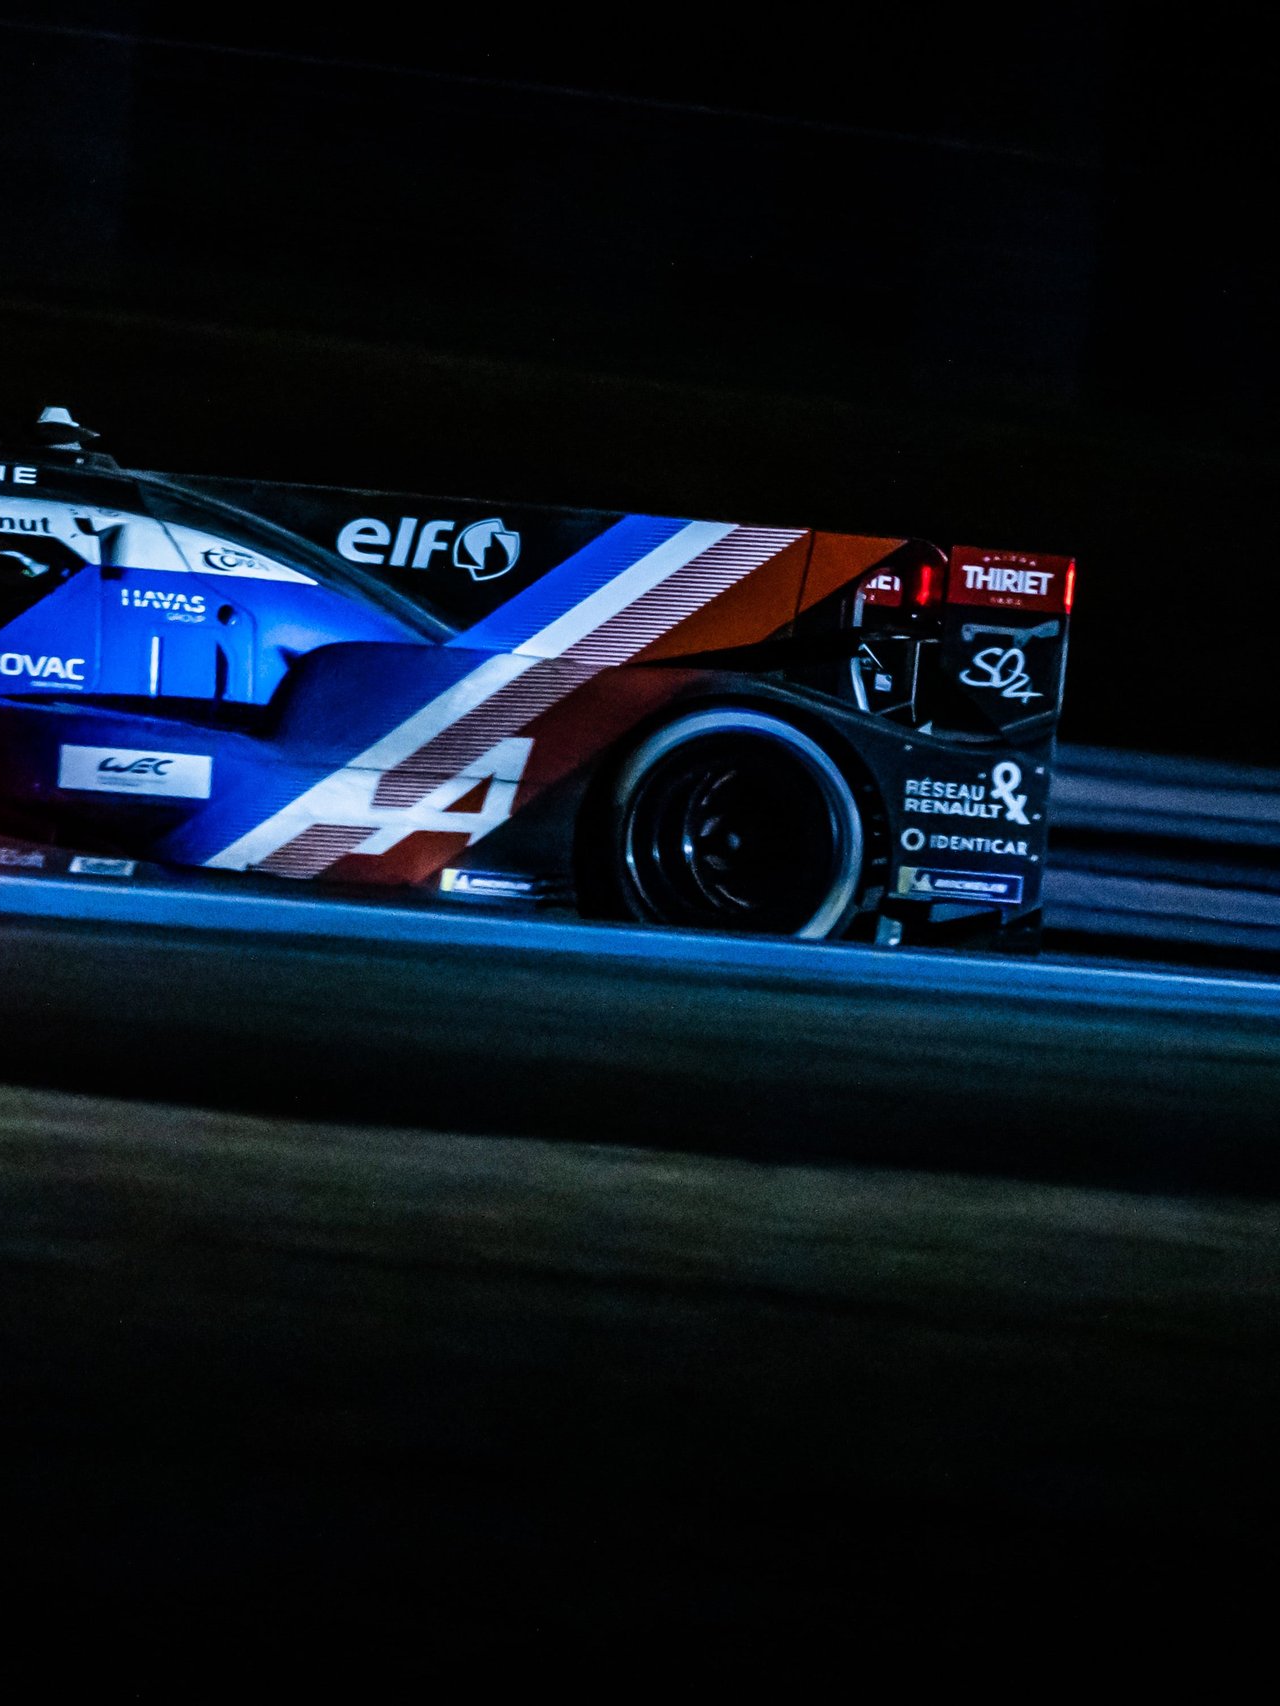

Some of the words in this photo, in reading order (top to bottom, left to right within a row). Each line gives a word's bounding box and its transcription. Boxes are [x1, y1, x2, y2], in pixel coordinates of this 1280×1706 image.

[336, 517, 455, 569] elf
[962, 564, 1055, 596] THIRIET
[121, 588, 206, 614] HAVAS
[98, 756, 174, 776] WEC
[904, 777, 986, 801] RÉSEAU
[903, 797, 1004, 819] RENAULT
[929, 834, 1028, 856] IDENTICAR
